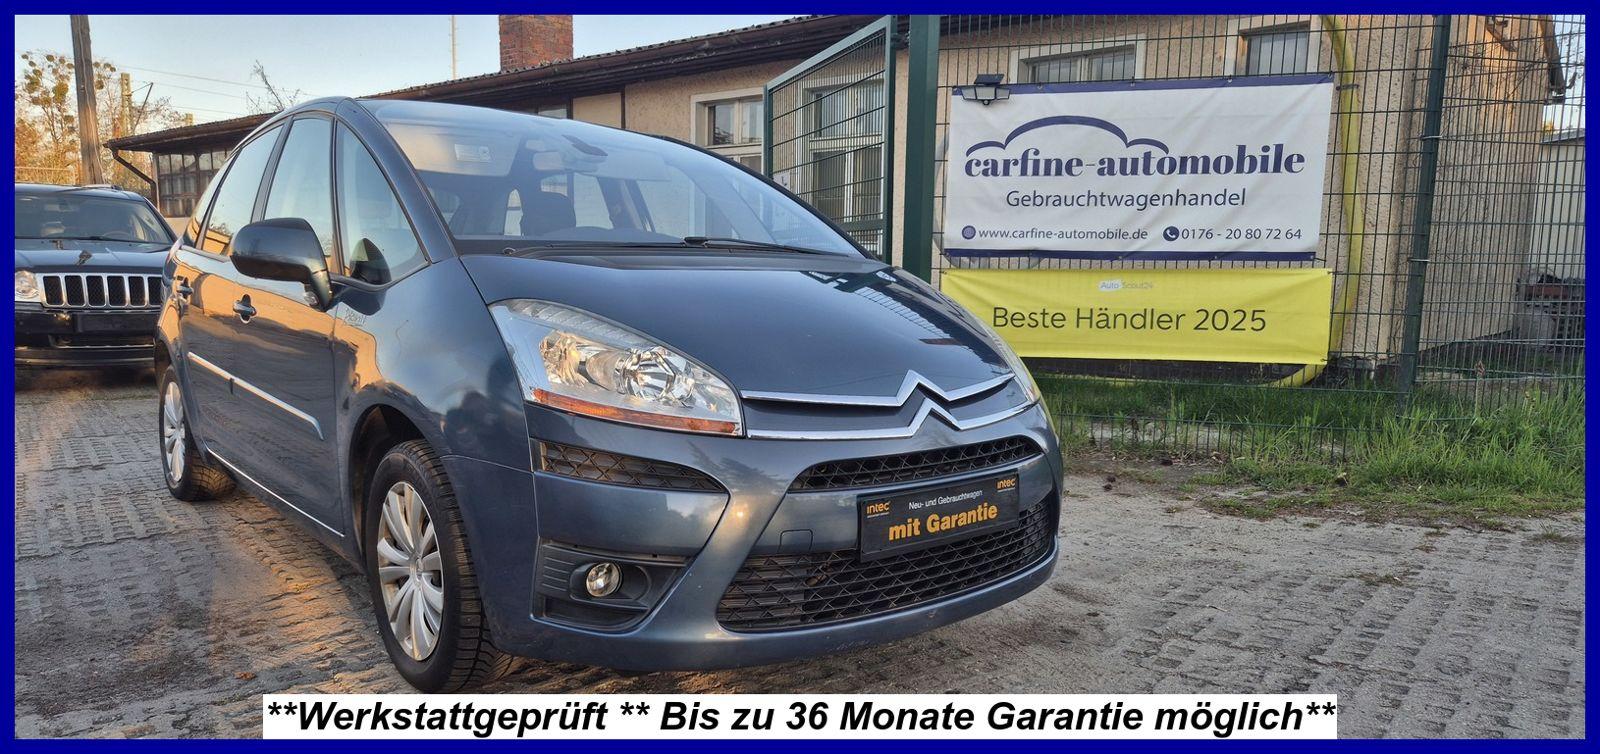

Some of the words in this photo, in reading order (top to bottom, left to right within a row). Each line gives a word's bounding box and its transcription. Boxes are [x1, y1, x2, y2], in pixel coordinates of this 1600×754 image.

[964, 143, 1306, 178] carfine-automobile
[1005, 188, 1247, 212] Gebrauchtwagenhandel
[978, 227, 1149, 241] www.carfine-automobile.de
[1181, 228, 1214, 240] 0176
[1225, 228, 1242, 240] 20
[1245, 228, 1262, 240] 80
[1265, 228, 1281, 240] 72
[1285, 228, 1303, 240] 64
[992, 307, 1067, 329] Beste
[1075, 308, 1186, 331] Händler
[1193, 308, 1267, 332] 2025
[908, 501, 925, 511] Neu-
[925, 498, 937, 508] und
[937, 490, 983, 505] Gebrauchtwagen
[888, 518, 921, 541] mit
[926, 503, 998, 533] Garantie
